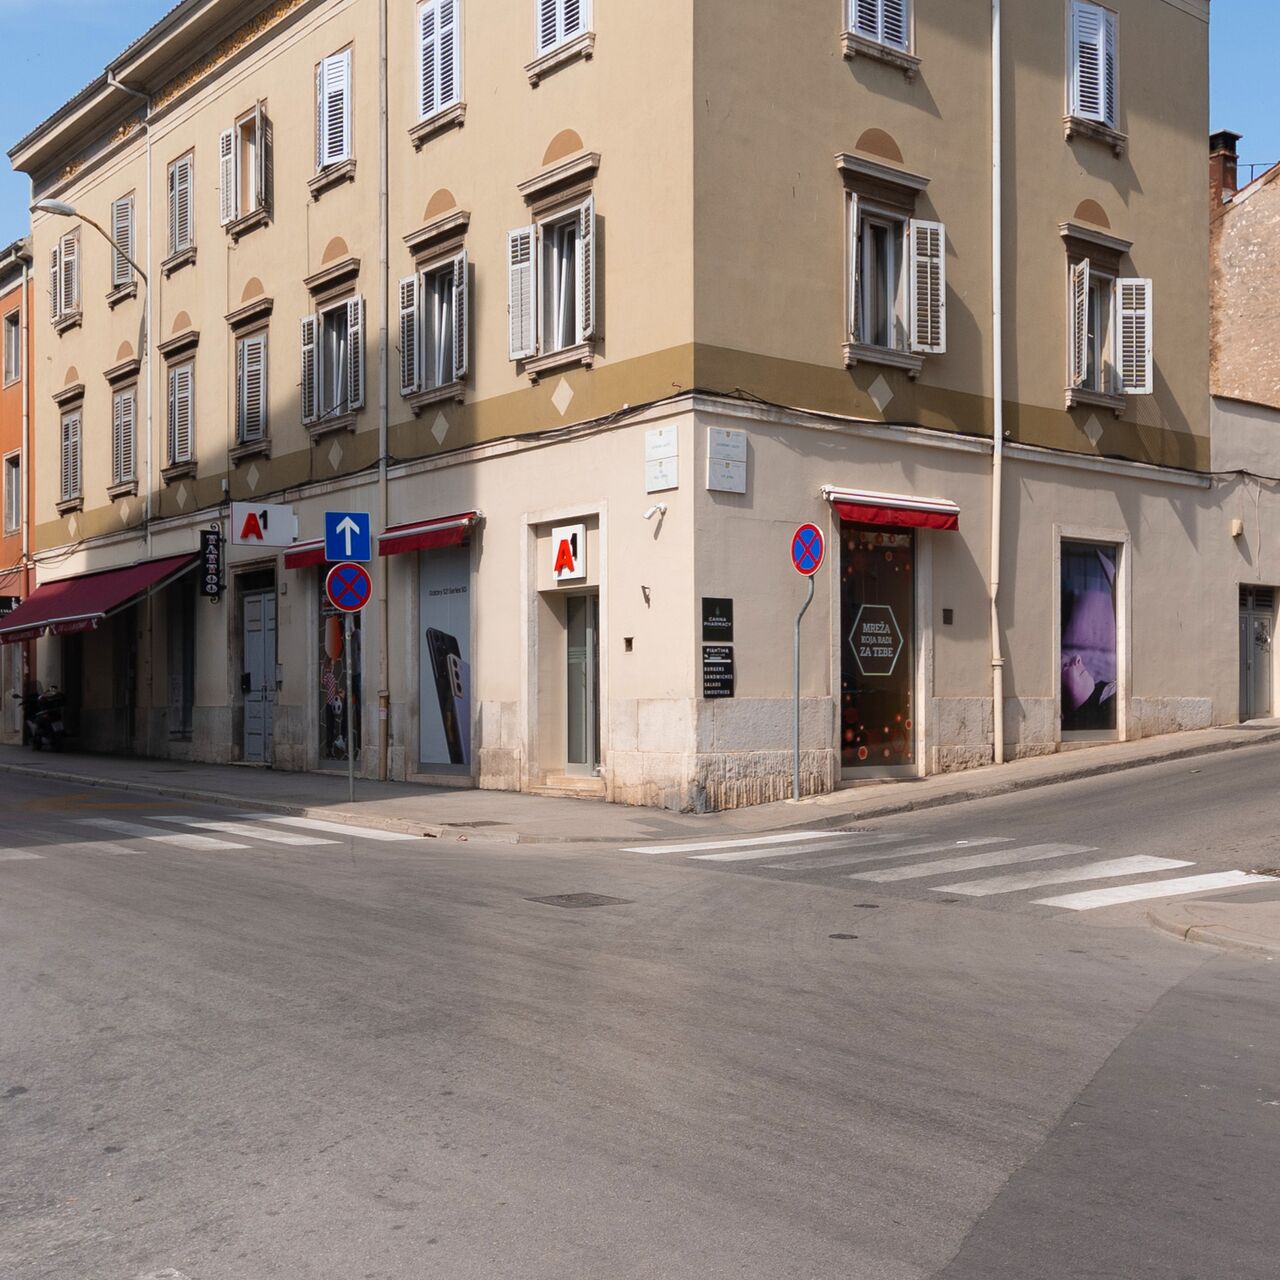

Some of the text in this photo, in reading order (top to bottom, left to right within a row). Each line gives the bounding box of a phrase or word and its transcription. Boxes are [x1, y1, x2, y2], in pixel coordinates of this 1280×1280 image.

[240, 510, 268, 540] A1
[554, 533, 577, 572] A1
[206, 535, 218, 593] TATTOO
[863, 621, 891, 634] MREŽA
[861, 636, 892, 645] KOJA RADI
[860, 646, 894, 657] ZA TEBE
